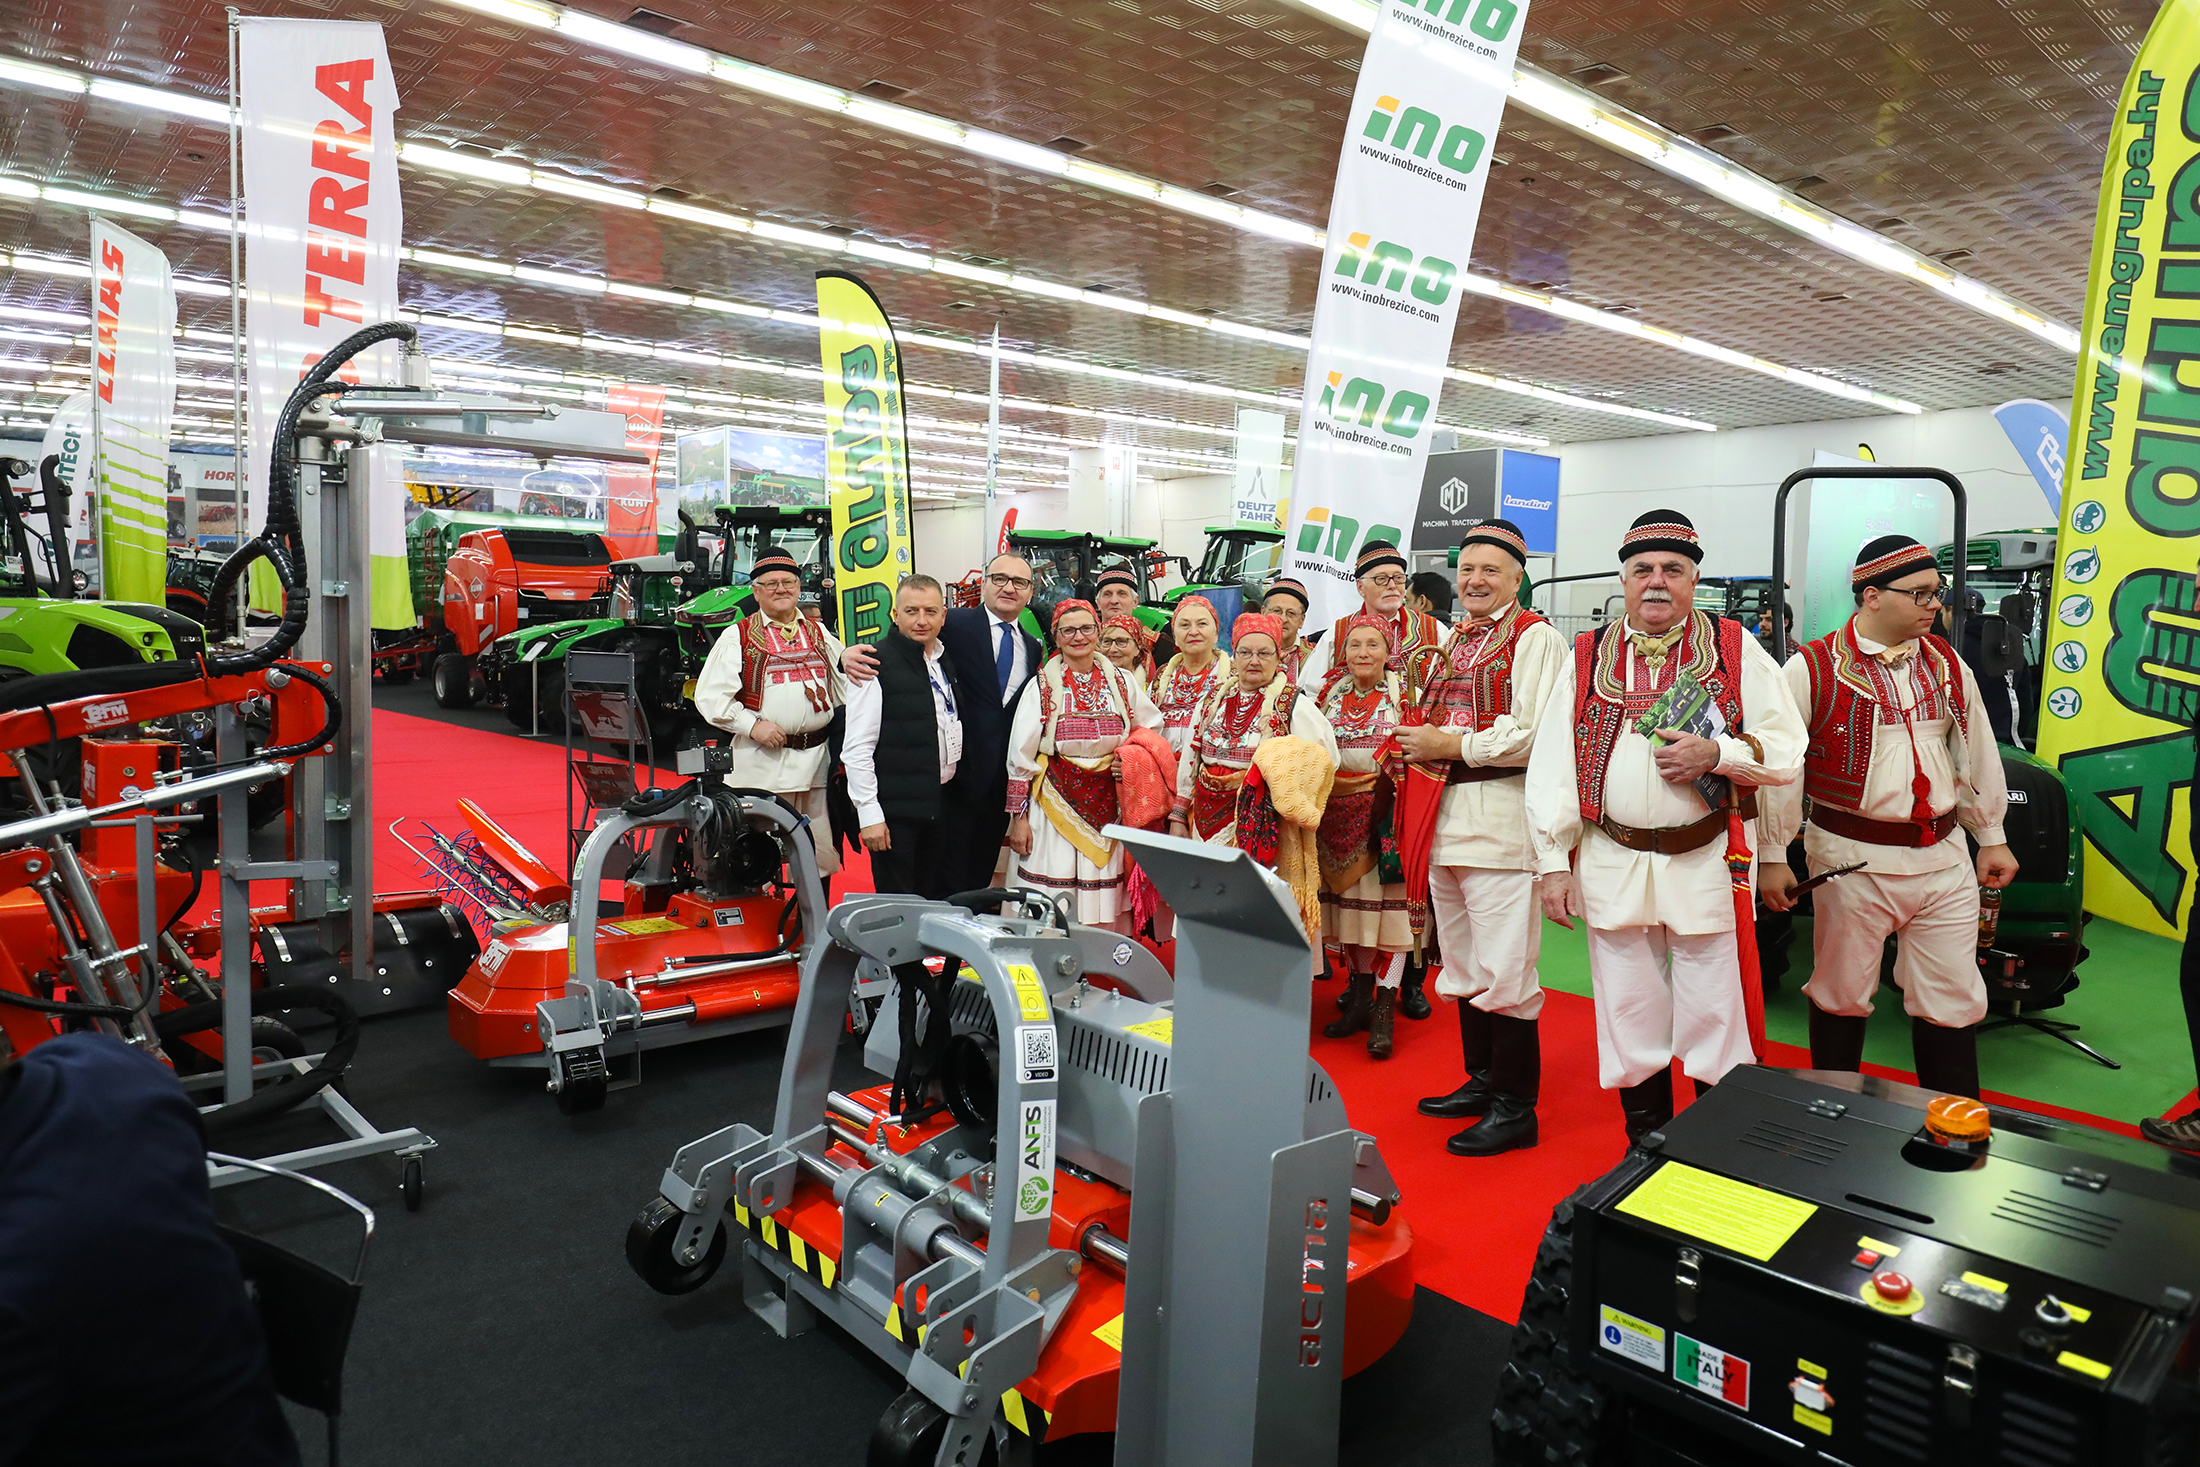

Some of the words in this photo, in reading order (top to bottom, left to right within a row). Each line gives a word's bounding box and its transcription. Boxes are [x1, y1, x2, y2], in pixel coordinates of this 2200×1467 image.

[1392, 8, 1498, 61] www.inobrezice.com
[1363, 95, 1486, 174] ino
[1360, 144, 1467, 192] www.inobrezice.com
[303, 58, 374, 328] TERRA
[1334, 232, 1457, 305] ino
[2081, 70, 2166, 481] www.amgrupa.hr
[1331, 282, 1440, 323] www.inobrezice.com
[1317, 370, 1430, 439] ino
[1237, 501, 1276, 512] DEUTZ
[1240, 511, 1273, 522] FAHR
[1422, 520, 1449, 528] MACHINA
[1451, 518, 1484, 527] TRACTORIA
[1503, 494, 1550, 511] Landini
[1024, 1106, 1041, 1170] ANFIS
[1621, 1317, 1652, 1336] WARNING
[1687, 1354, 1734, 1384] ITALY
[1694, 1347, 1718, 1363] MADE
[1722, 1359, 1730, 1368] IN
